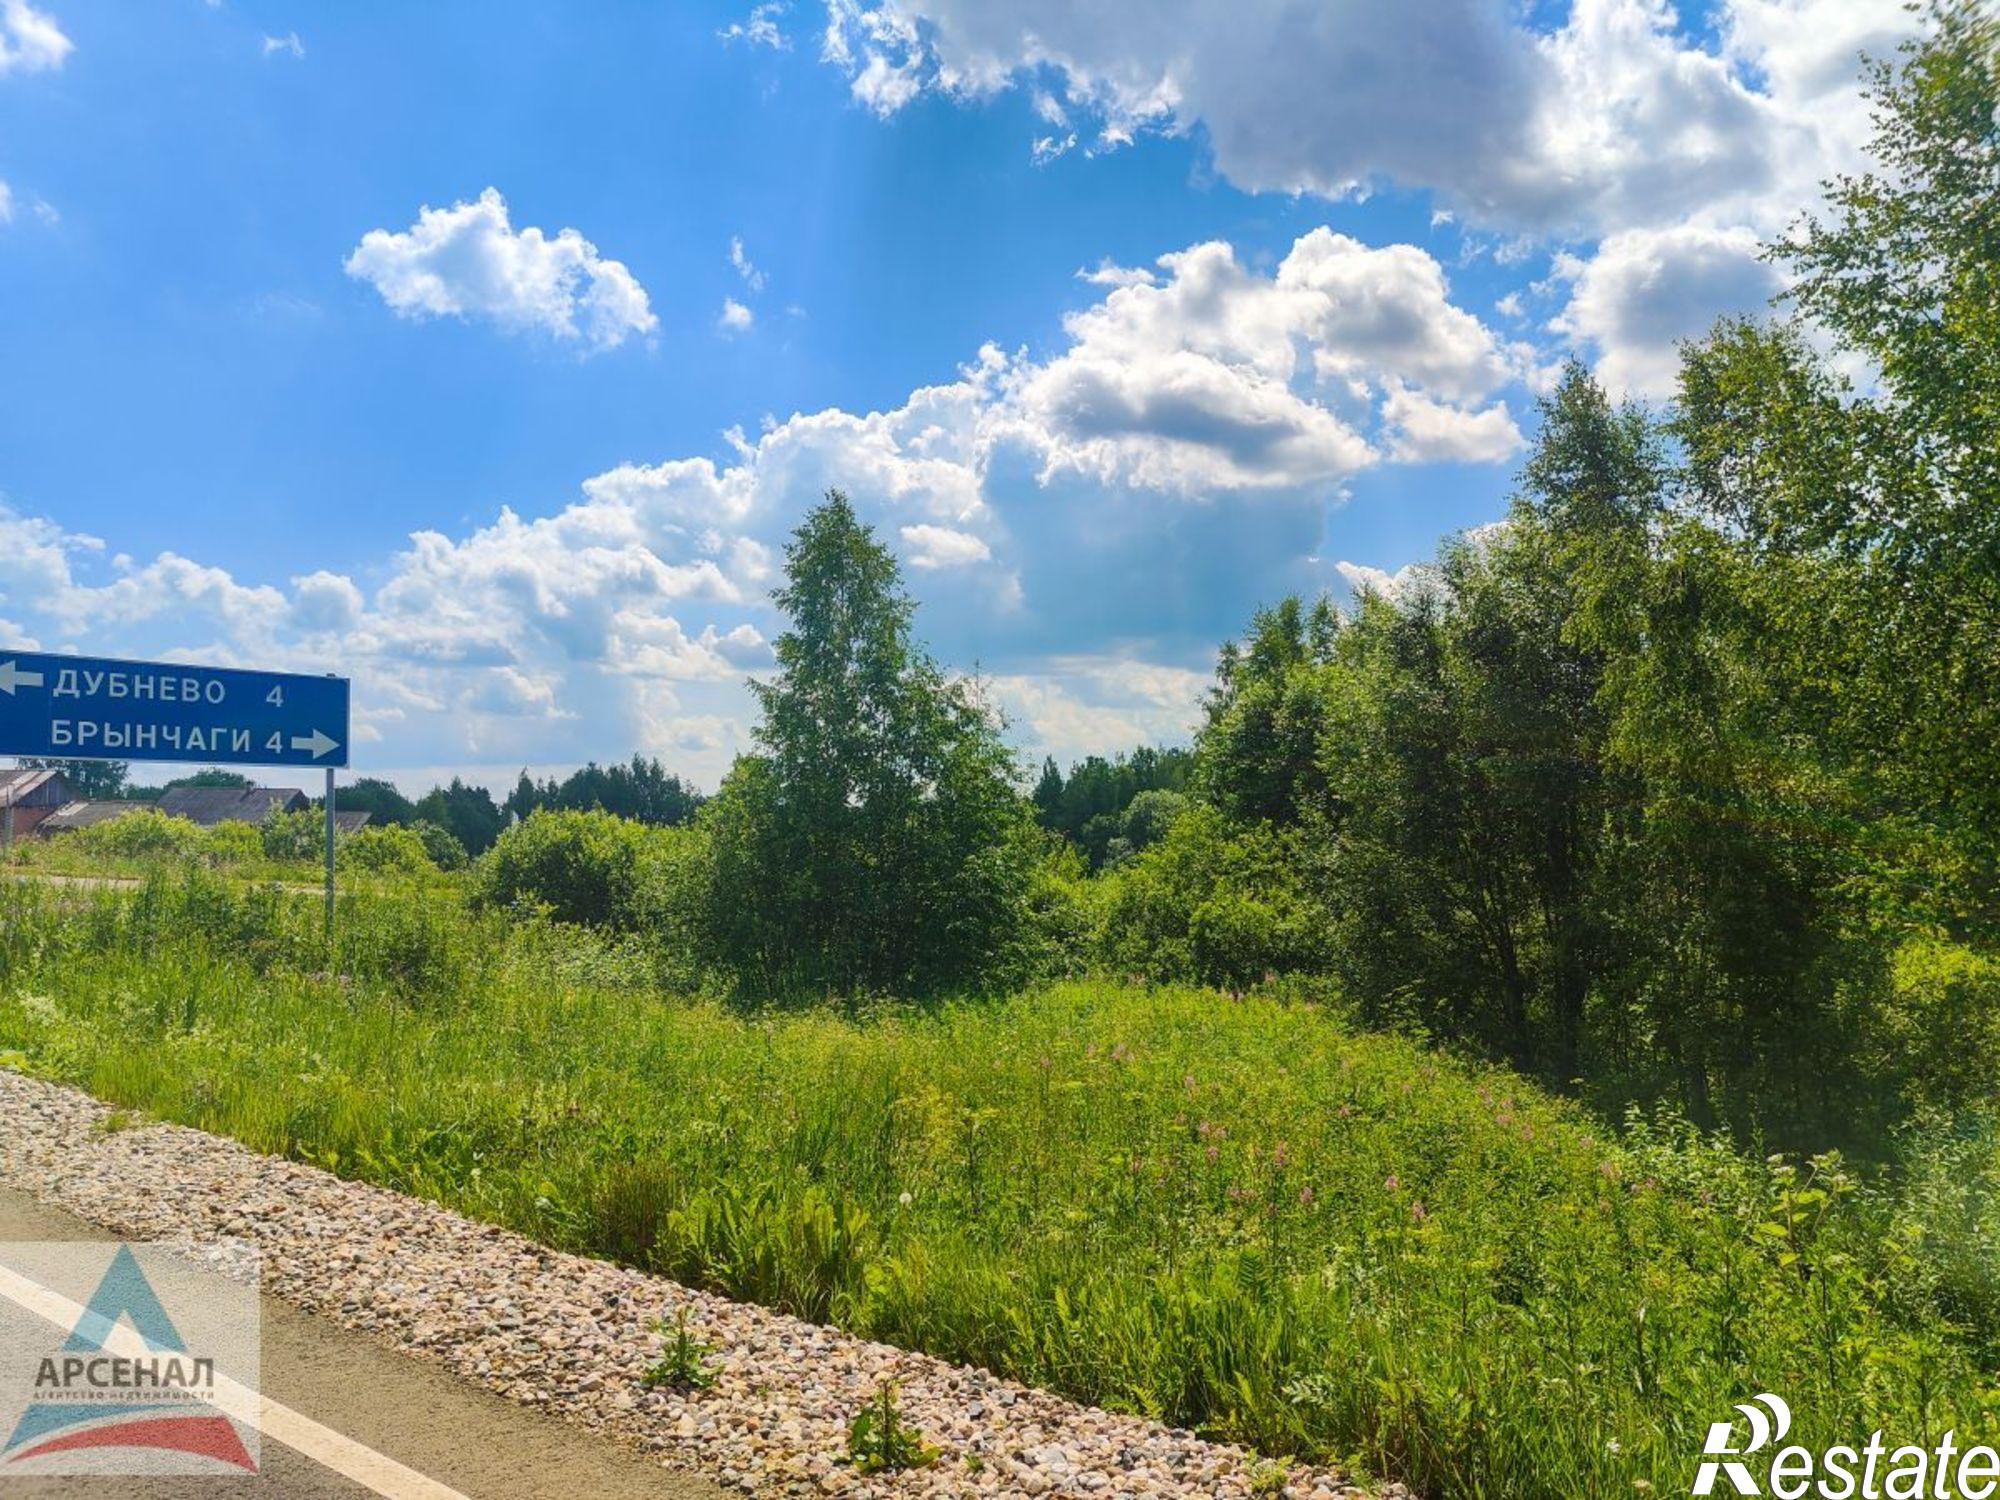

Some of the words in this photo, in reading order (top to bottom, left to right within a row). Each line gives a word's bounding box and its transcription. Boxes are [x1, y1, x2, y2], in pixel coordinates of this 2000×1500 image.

[53, 669, 226, 704] ДУБНЕВО
[265, 685, 284, 707] 4
[52, 719, 250, 752] БРЫНЧАГИ
[265, 731, 283, 754] 4
